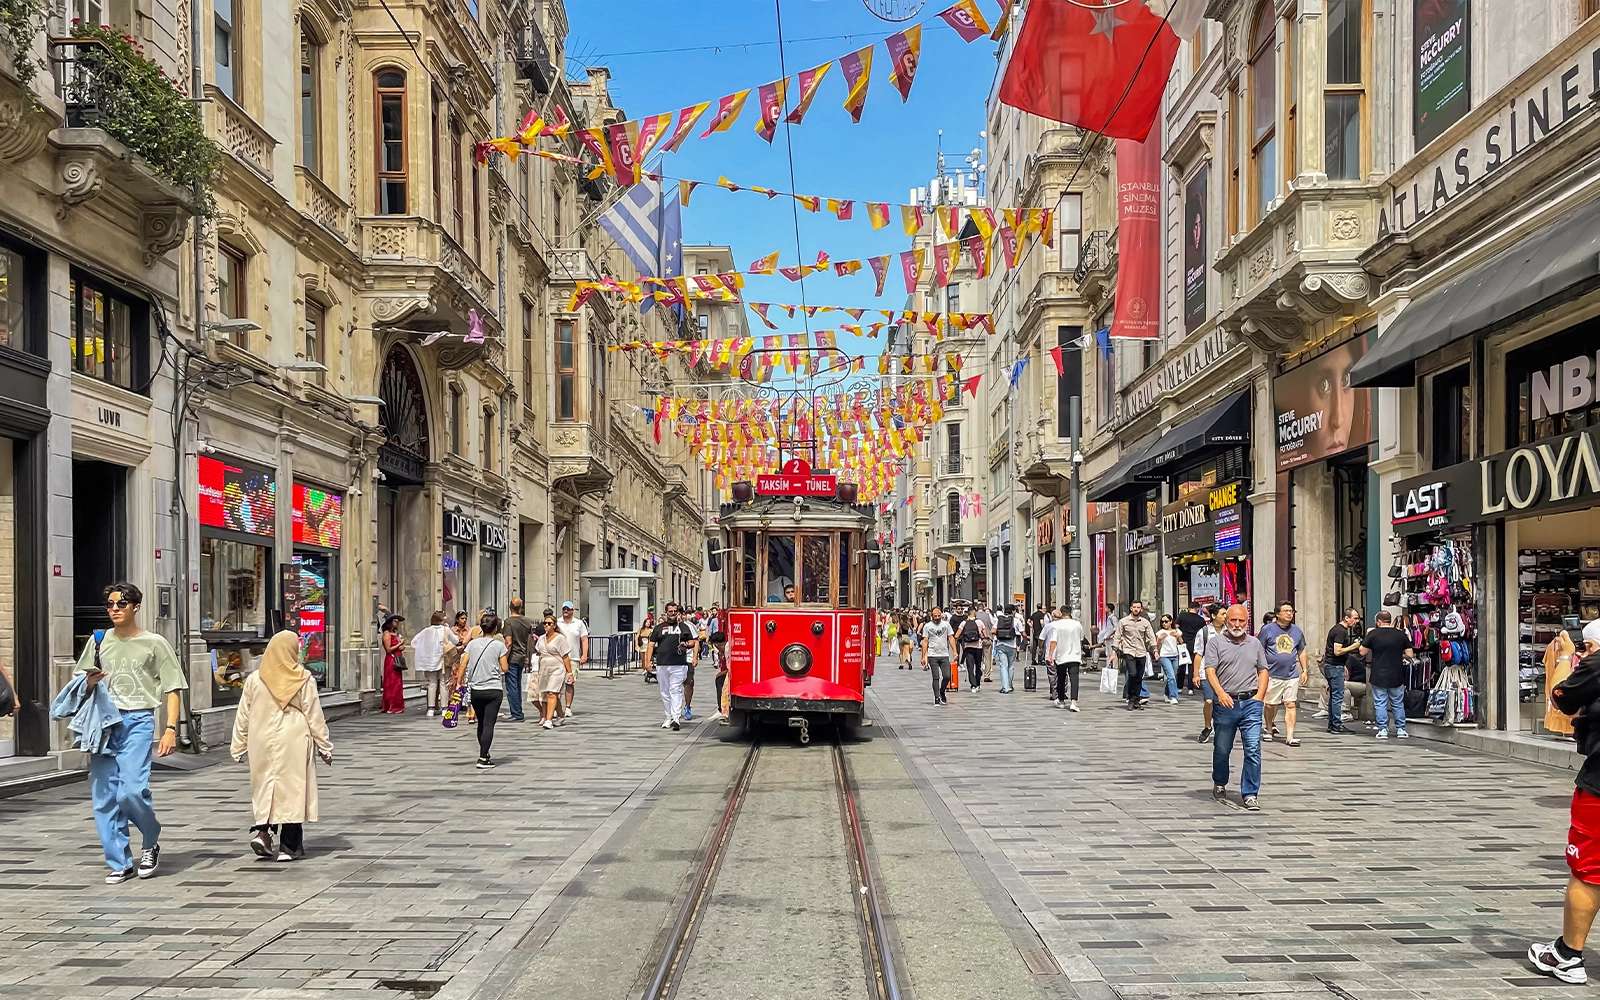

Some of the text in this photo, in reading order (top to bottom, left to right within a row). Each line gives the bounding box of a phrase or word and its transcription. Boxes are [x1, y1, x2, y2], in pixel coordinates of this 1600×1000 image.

[1421, 33, 1437, 53] STEVE
[1421, 18, 1463, 69] McCURRY
[1378, 47, 1600, 240] ATLAS SİNE
[1278, 409, 1295, 425] STEVE
[1279, 410, 1324, 443] McCURRY
[793, 460, 800, 473] 2
[760, 477, 790, 491] TAKSİM
[805, 478, 832, 491] TÜNEL
[1209, 483, 1237, 511] CHANGE
[1392, 482, 1443, 519] LAST
[451, 513, 477, 541] DESA
[1162, 513, 1178, 533] CITY
[1180, 501, 1205, 529] DÖNER
[486, 524, 507, 549] DESA
[662, 625, 681, 635] FILA
